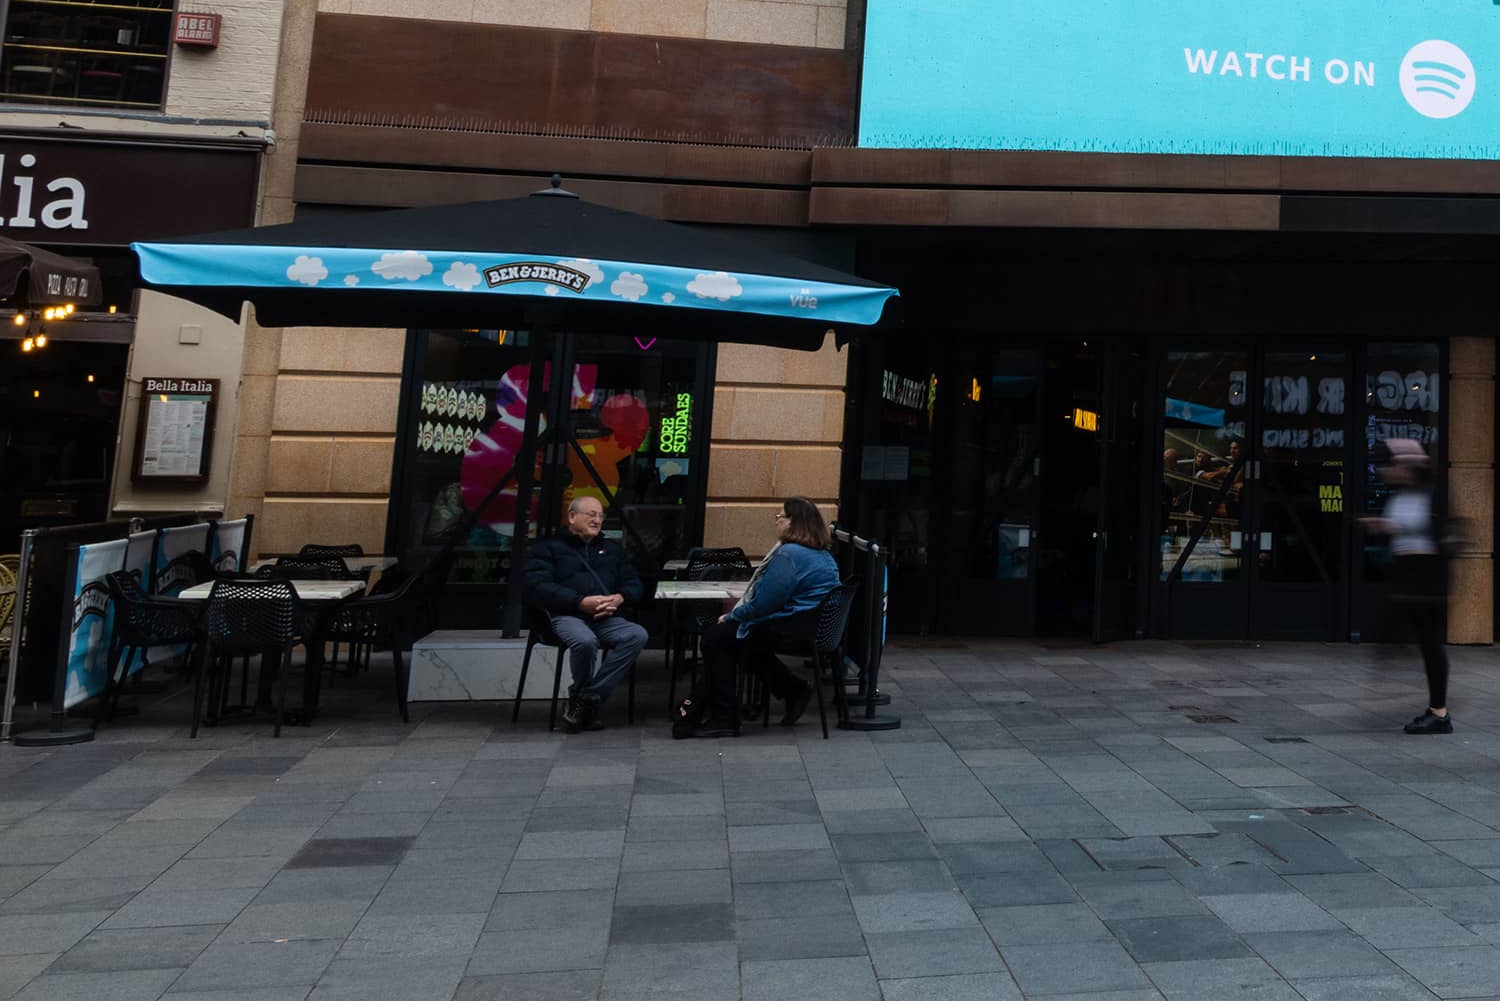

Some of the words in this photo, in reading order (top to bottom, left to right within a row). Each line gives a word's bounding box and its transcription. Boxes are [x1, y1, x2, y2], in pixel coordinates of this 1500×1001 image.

[1183, 46, 1312, 83] WATCH
[1324, 55, 1377, 88] ON
[146, 379, 178, 393] Bella
[179, 380, 214, 393] Italia
